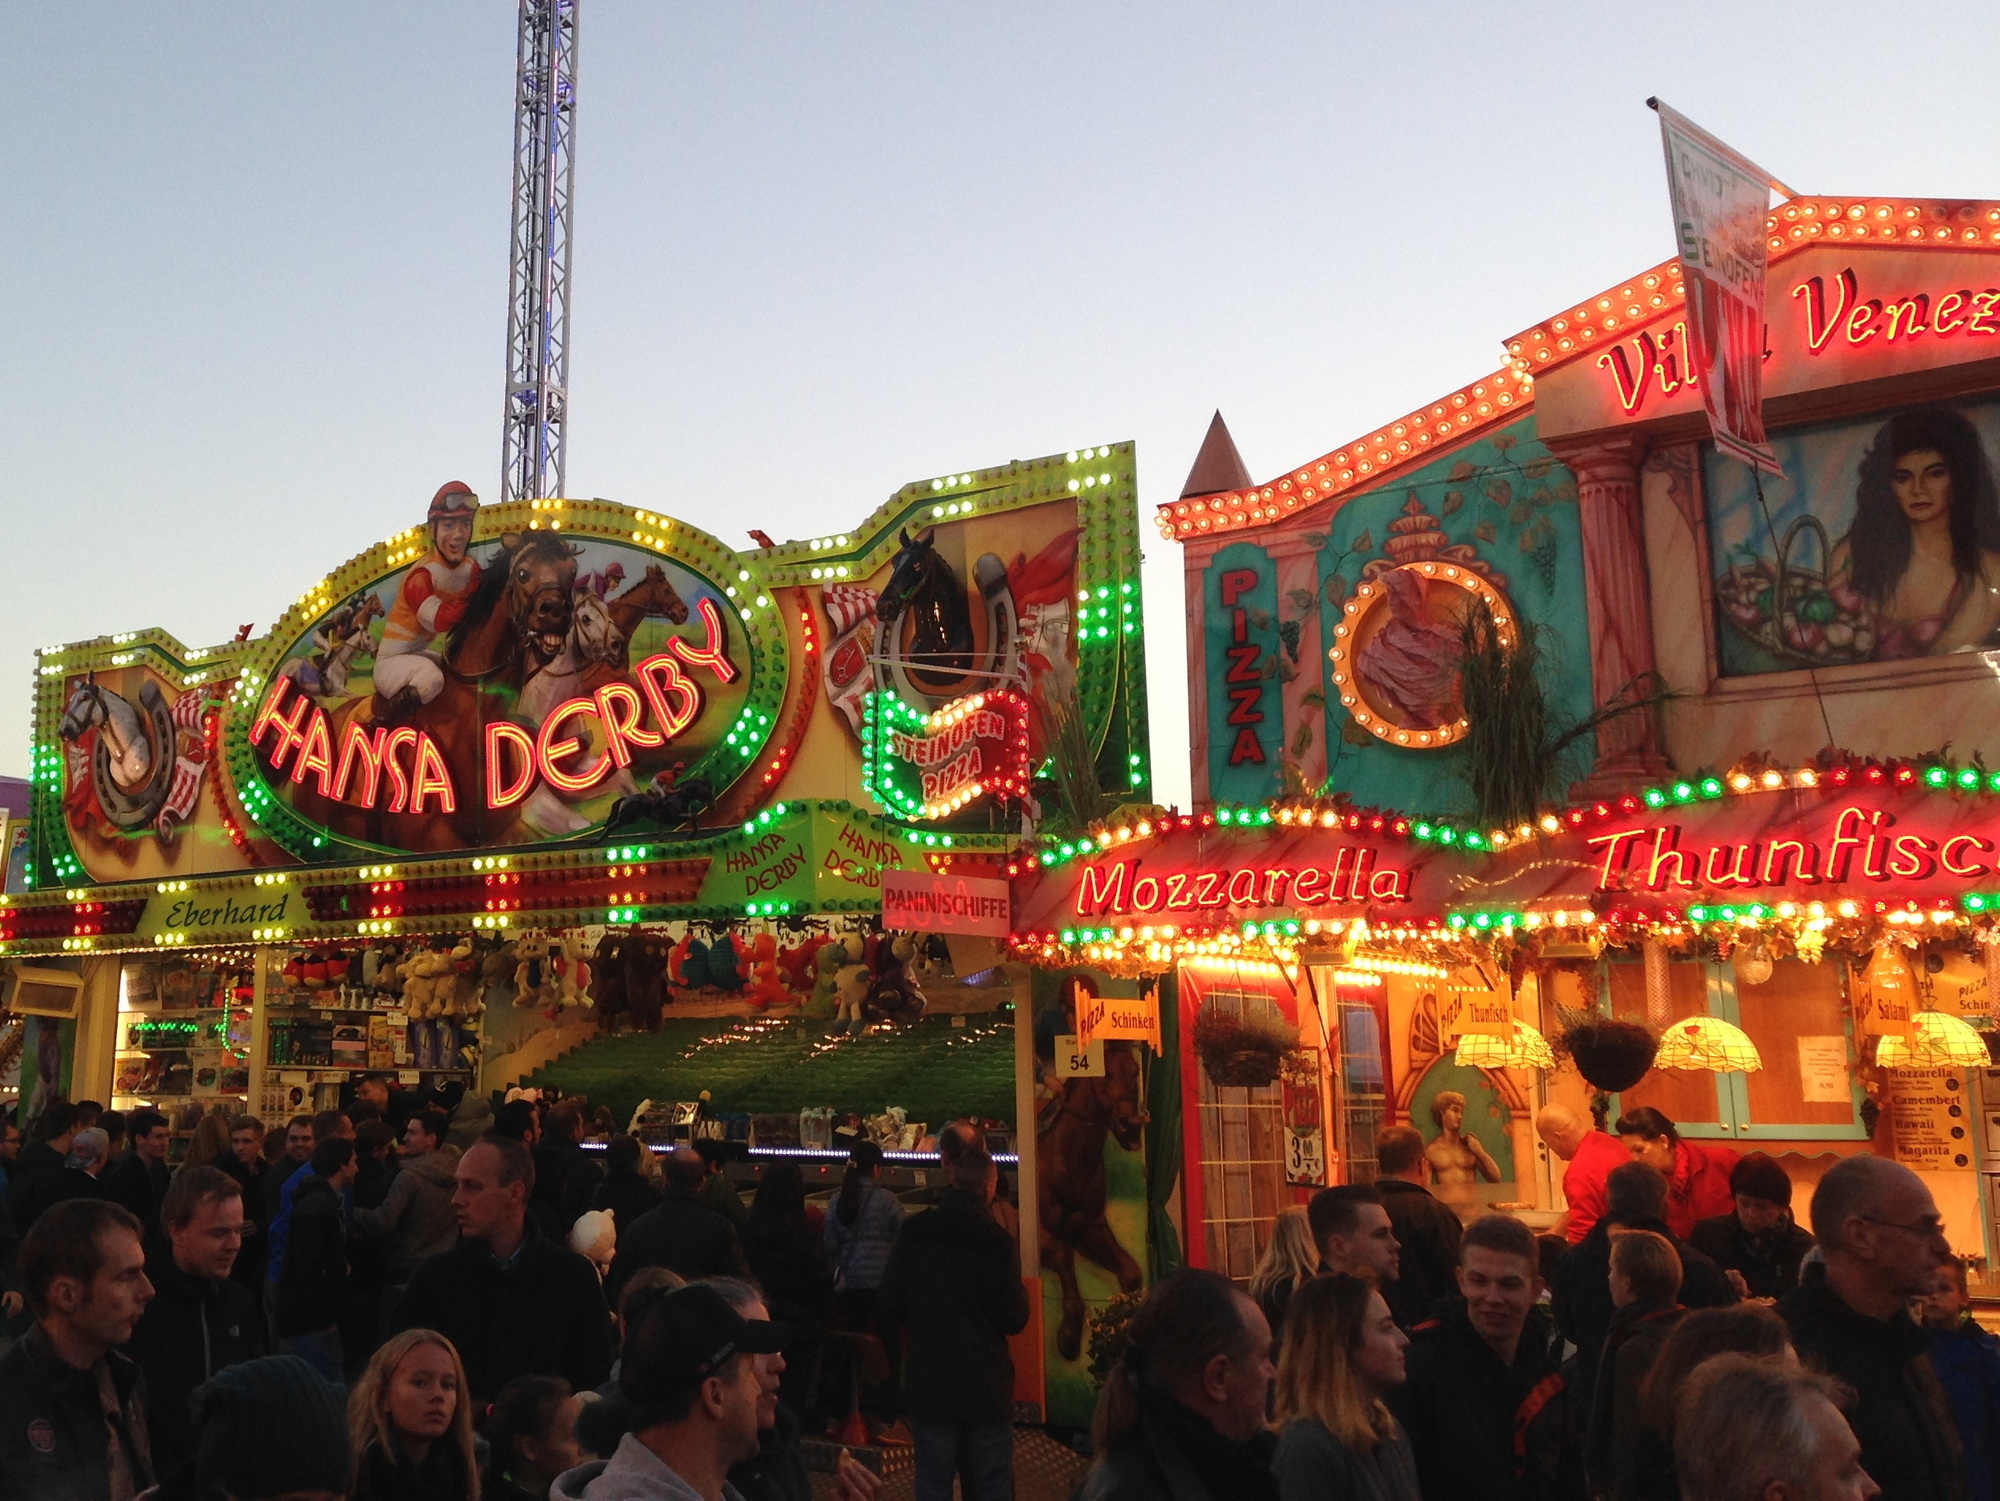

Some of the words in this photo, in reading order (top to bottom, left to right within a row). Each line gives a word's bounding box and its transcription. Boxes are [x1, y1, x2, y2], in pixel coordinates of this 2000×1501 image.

[1681, 222, 1763, 302] SEINOFEN
[1597, 322, 1772, 417] Vil
[1221, 569, 1265, 766] PIZZA
[249, 675, 456, 813] HANSA
[485, 597, 736, 810] DERBY
[891, 710, 1004, 766] STEINOFEN
[923, 747, 981, 800] PIZZA
[725, 833, 786, 873] HANSA
[838, 822, 903, 865] HANSA
[1588, 807, 2000, 893] Thunfisc
[745, 844, 807, 896] DERBY
[824, 849, 883, 888] DERB
[1077, 847, 1413, 916] Mozzarella
[165, 893, 289, 928] Eberhard
[885, 888, 1008, 919] PANINISCHIFFE
[1958, 977, 1987, 998] PIZZA
[1081, 1001, 1105, 1038] PIZZA
[1111, 1011, 1154, 1029] Schinken
[1070, 1055, 1089, 1070] 54
[1890, 1068, 1953, 1078] Mozzarella
[1892, 1095, 1961, 1105] Camembert
[1895, 1120, 1934, 1129] Hawaii
[1898, 1146, 1950, 1157] Magarita
